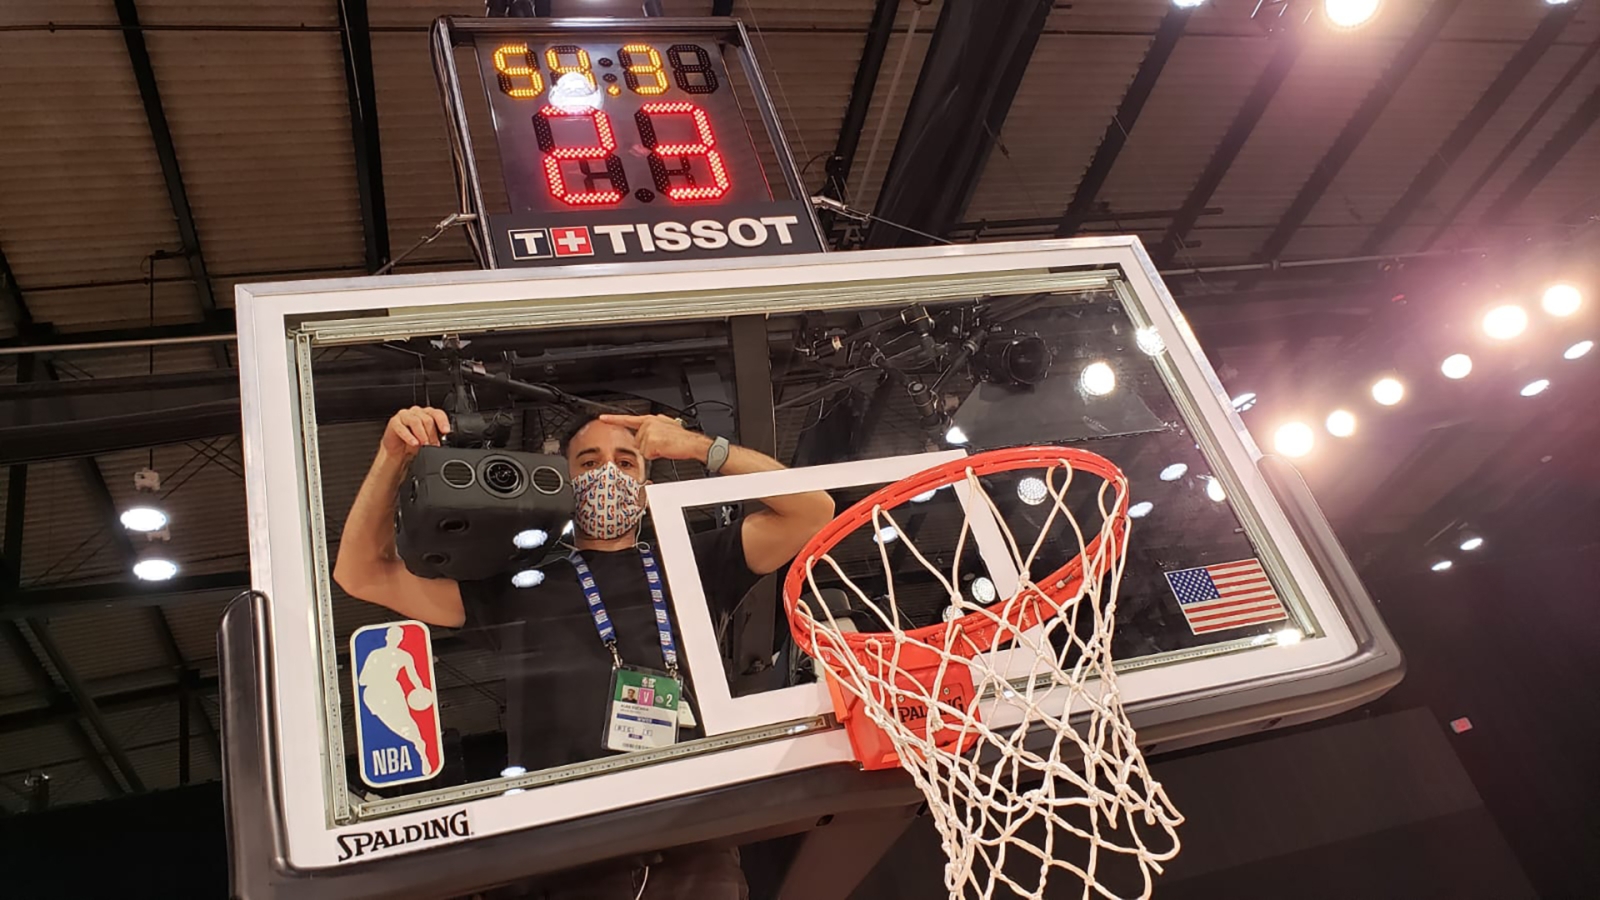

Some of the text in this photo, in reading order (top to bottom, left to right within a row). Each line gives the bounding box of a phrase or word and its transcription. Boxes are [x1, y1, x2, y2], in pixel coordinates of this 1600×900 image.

[541, 101, 731, 205] 23
[593, 216, 799, 255] TISSOT
[889, 695, 965, 724] PALNG
[372, 745, 413, 776] NBA
[336, 809, 470, 862] SPALDING
